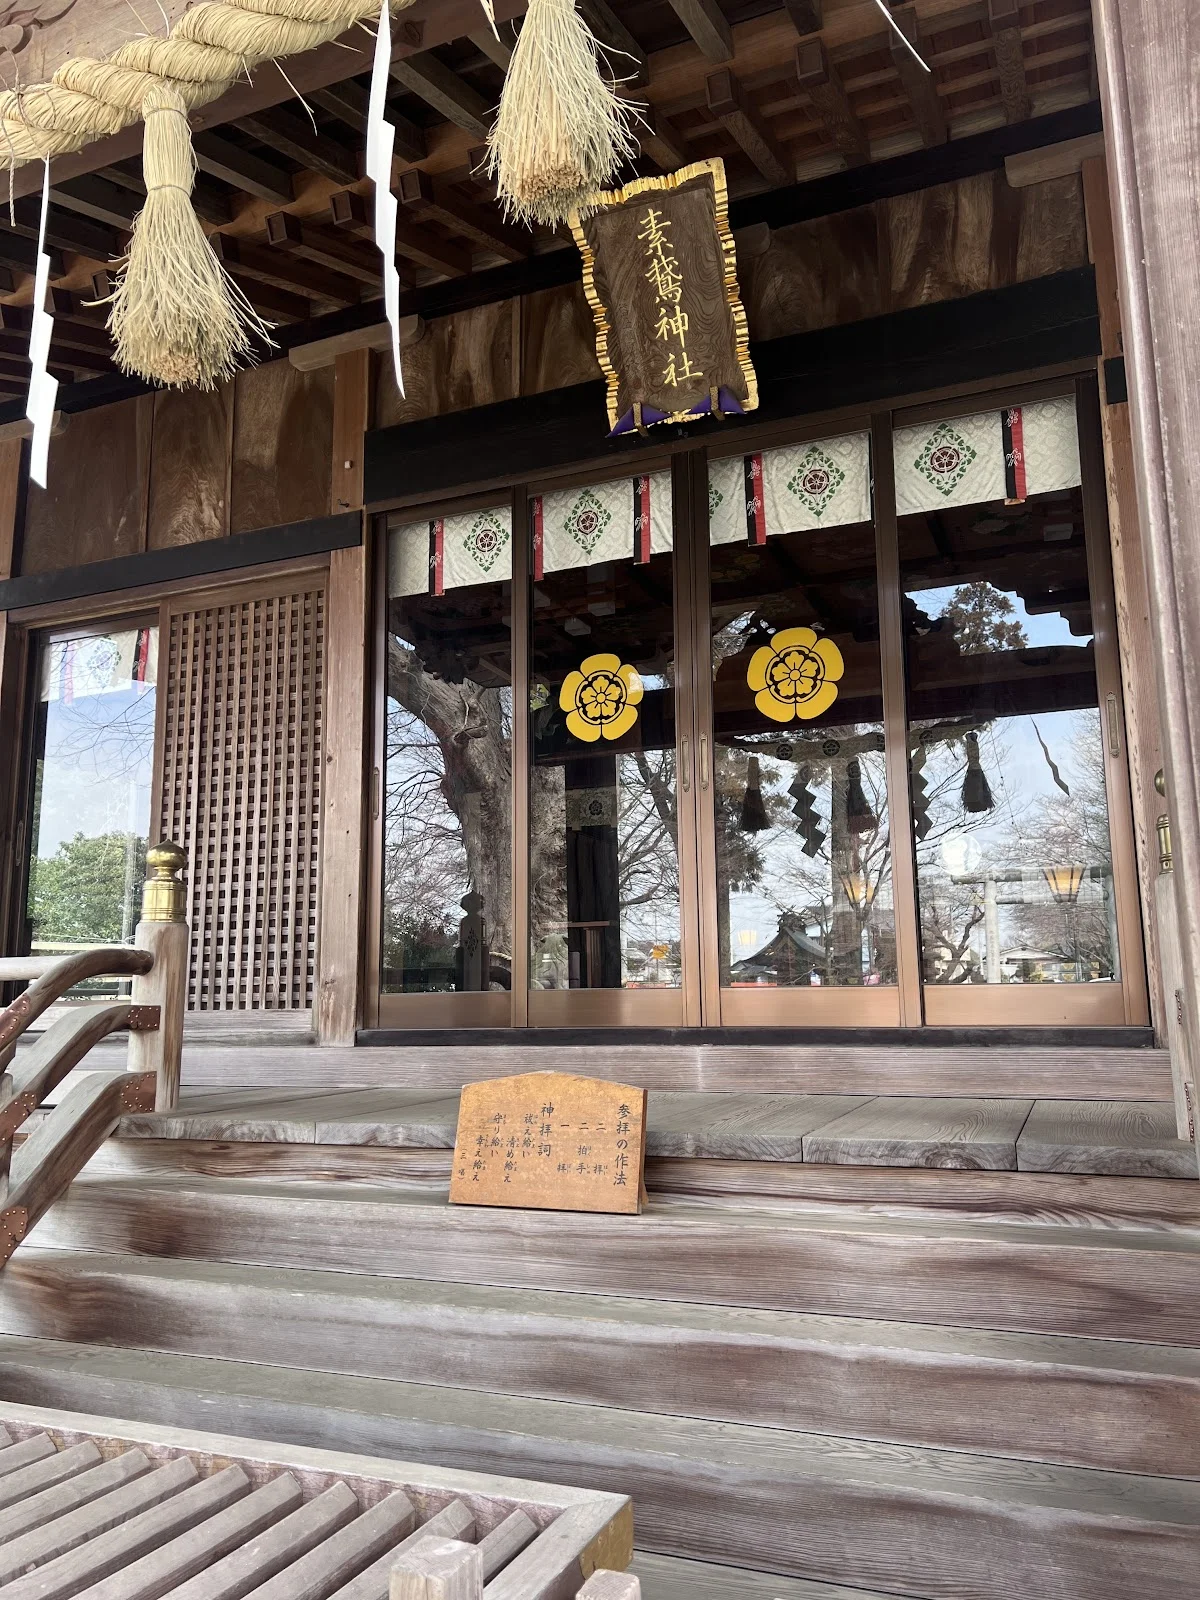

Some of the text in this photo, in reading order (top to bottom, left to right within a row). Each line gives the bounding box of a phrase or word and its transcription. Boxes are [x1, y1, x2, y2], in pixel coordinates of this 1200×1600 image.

[637, 208, 704, 387] 素鵞神社
[490, 1112, 503, 1158] 守り給い
[538, 1102, 555, 1158] 神拝詞
[613, 1104, 631, 1186] 参拝の作法
[503, 1137, 516, 1183] 清め給え
